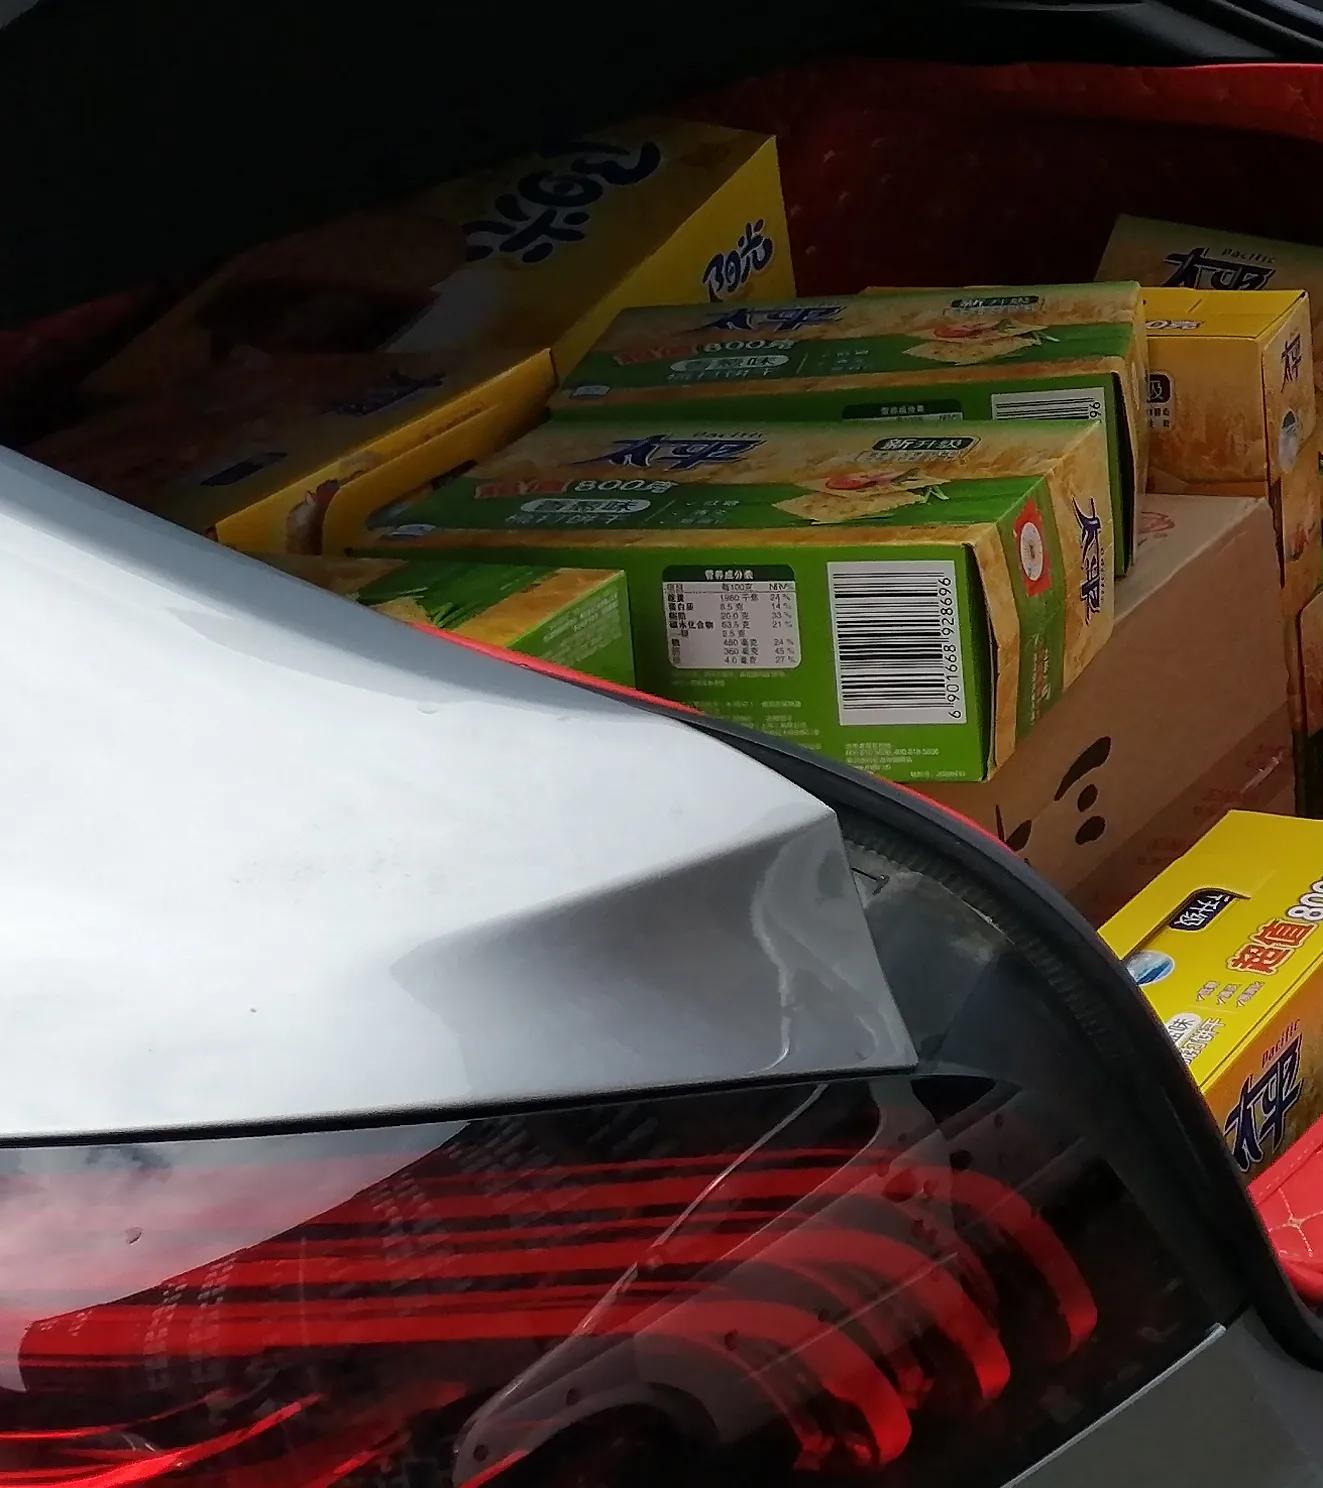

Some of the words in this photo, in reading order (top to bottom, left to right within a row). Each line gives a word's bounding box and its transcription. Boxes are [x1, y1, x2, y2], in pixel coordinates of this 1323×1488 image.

[876, 437, 964, 451] 新升级
[938, 577, 956, 636] 928696
[943, 644, 960, 702] 901668
[1260, 1018, 1301, 1067] Pacific
